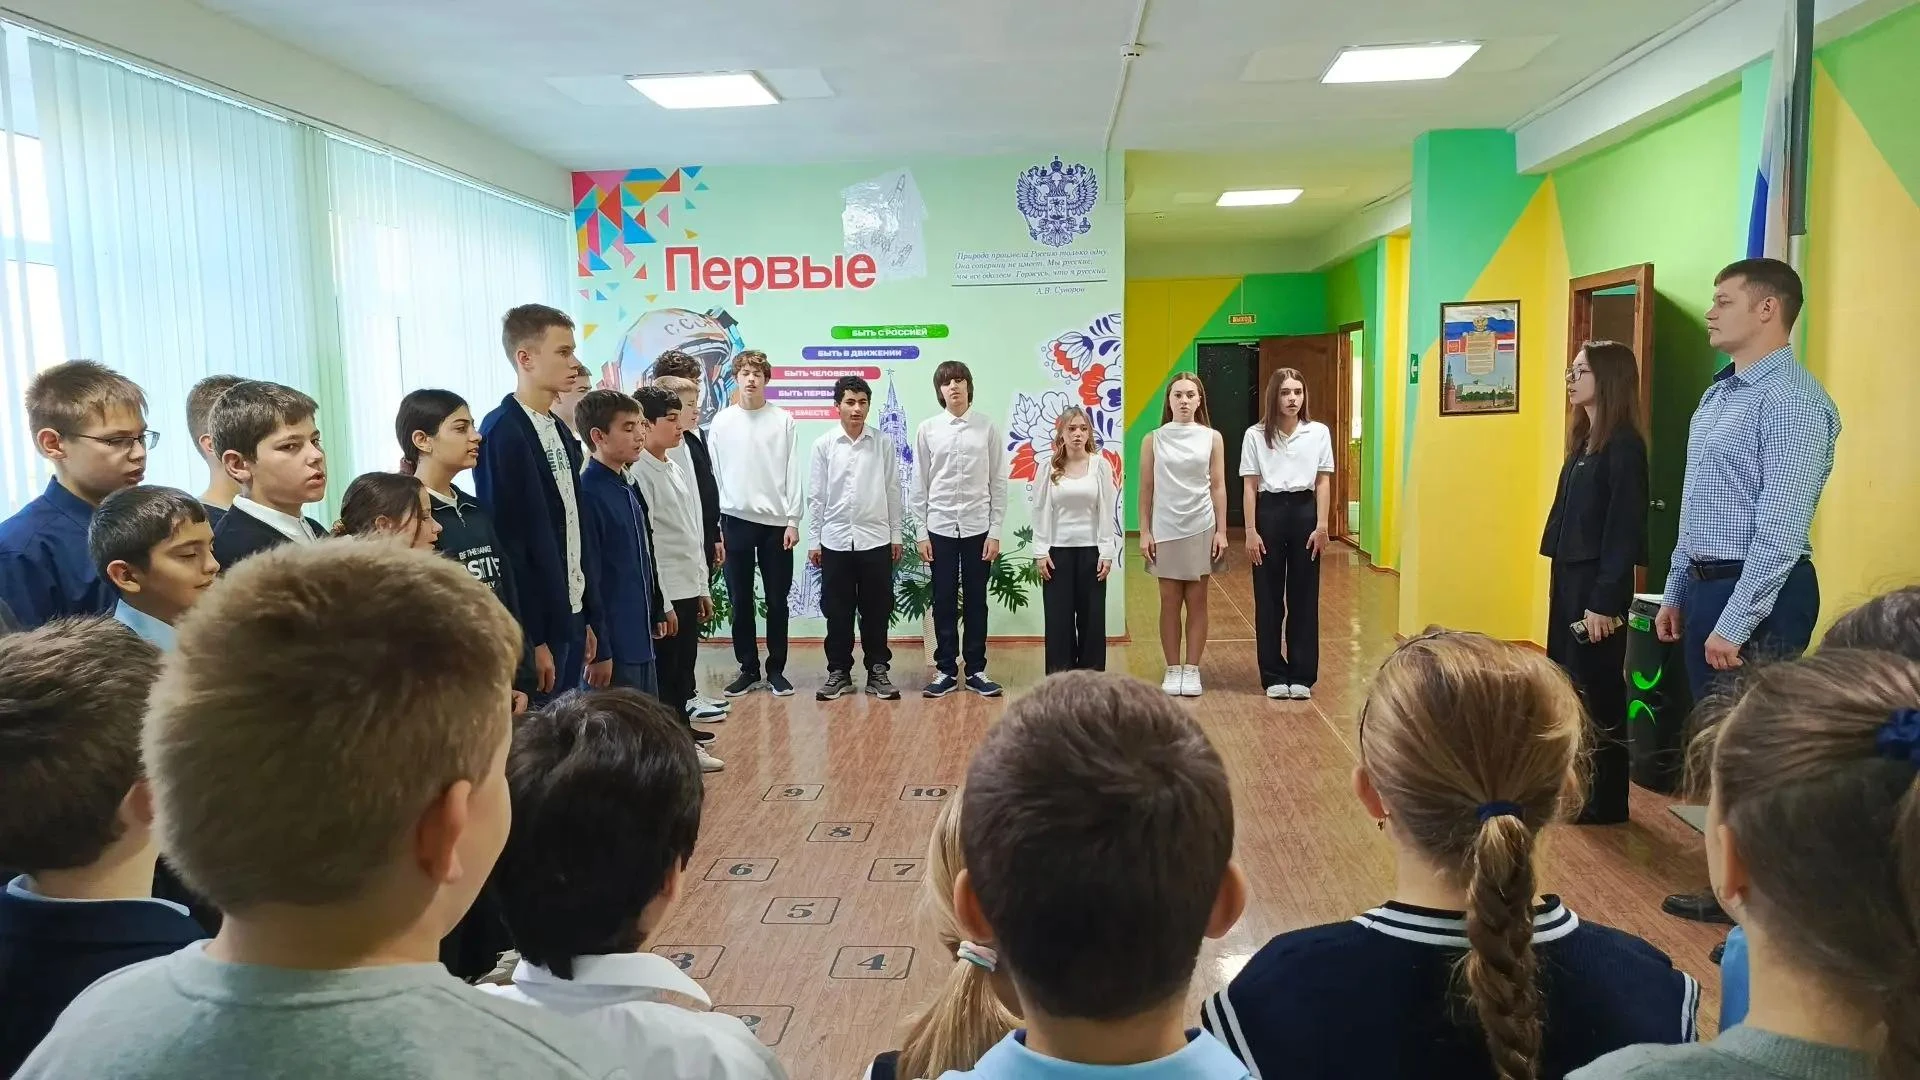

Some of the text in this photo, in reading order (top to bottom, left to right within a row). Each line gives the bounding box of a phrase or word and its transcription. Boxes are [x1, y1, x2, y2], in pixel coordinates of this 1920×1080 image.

[1047, 259, 1060, 267] Мы
[665, 246, 877, 306] Первые
[852, 329, 877, 337] БЫТЬ
[884, 328, 928, 336] РОССИЕЙ
[850, 349, 902, 357] ДВИЖЕНИИ
[795, 409, 830, 417] ВМЕСТЕ
[783, 787, 804, 797] 9
[911, 788, 948, 797] 10
[827, 826, 852, 838] 8
[729, 863, 754, 876] 6
[893, 863, 916, 876] 7
[786, 902, 815, 919] 5
[669, 952, 695, 970] 3
[857, 953, 888, 971] 4
